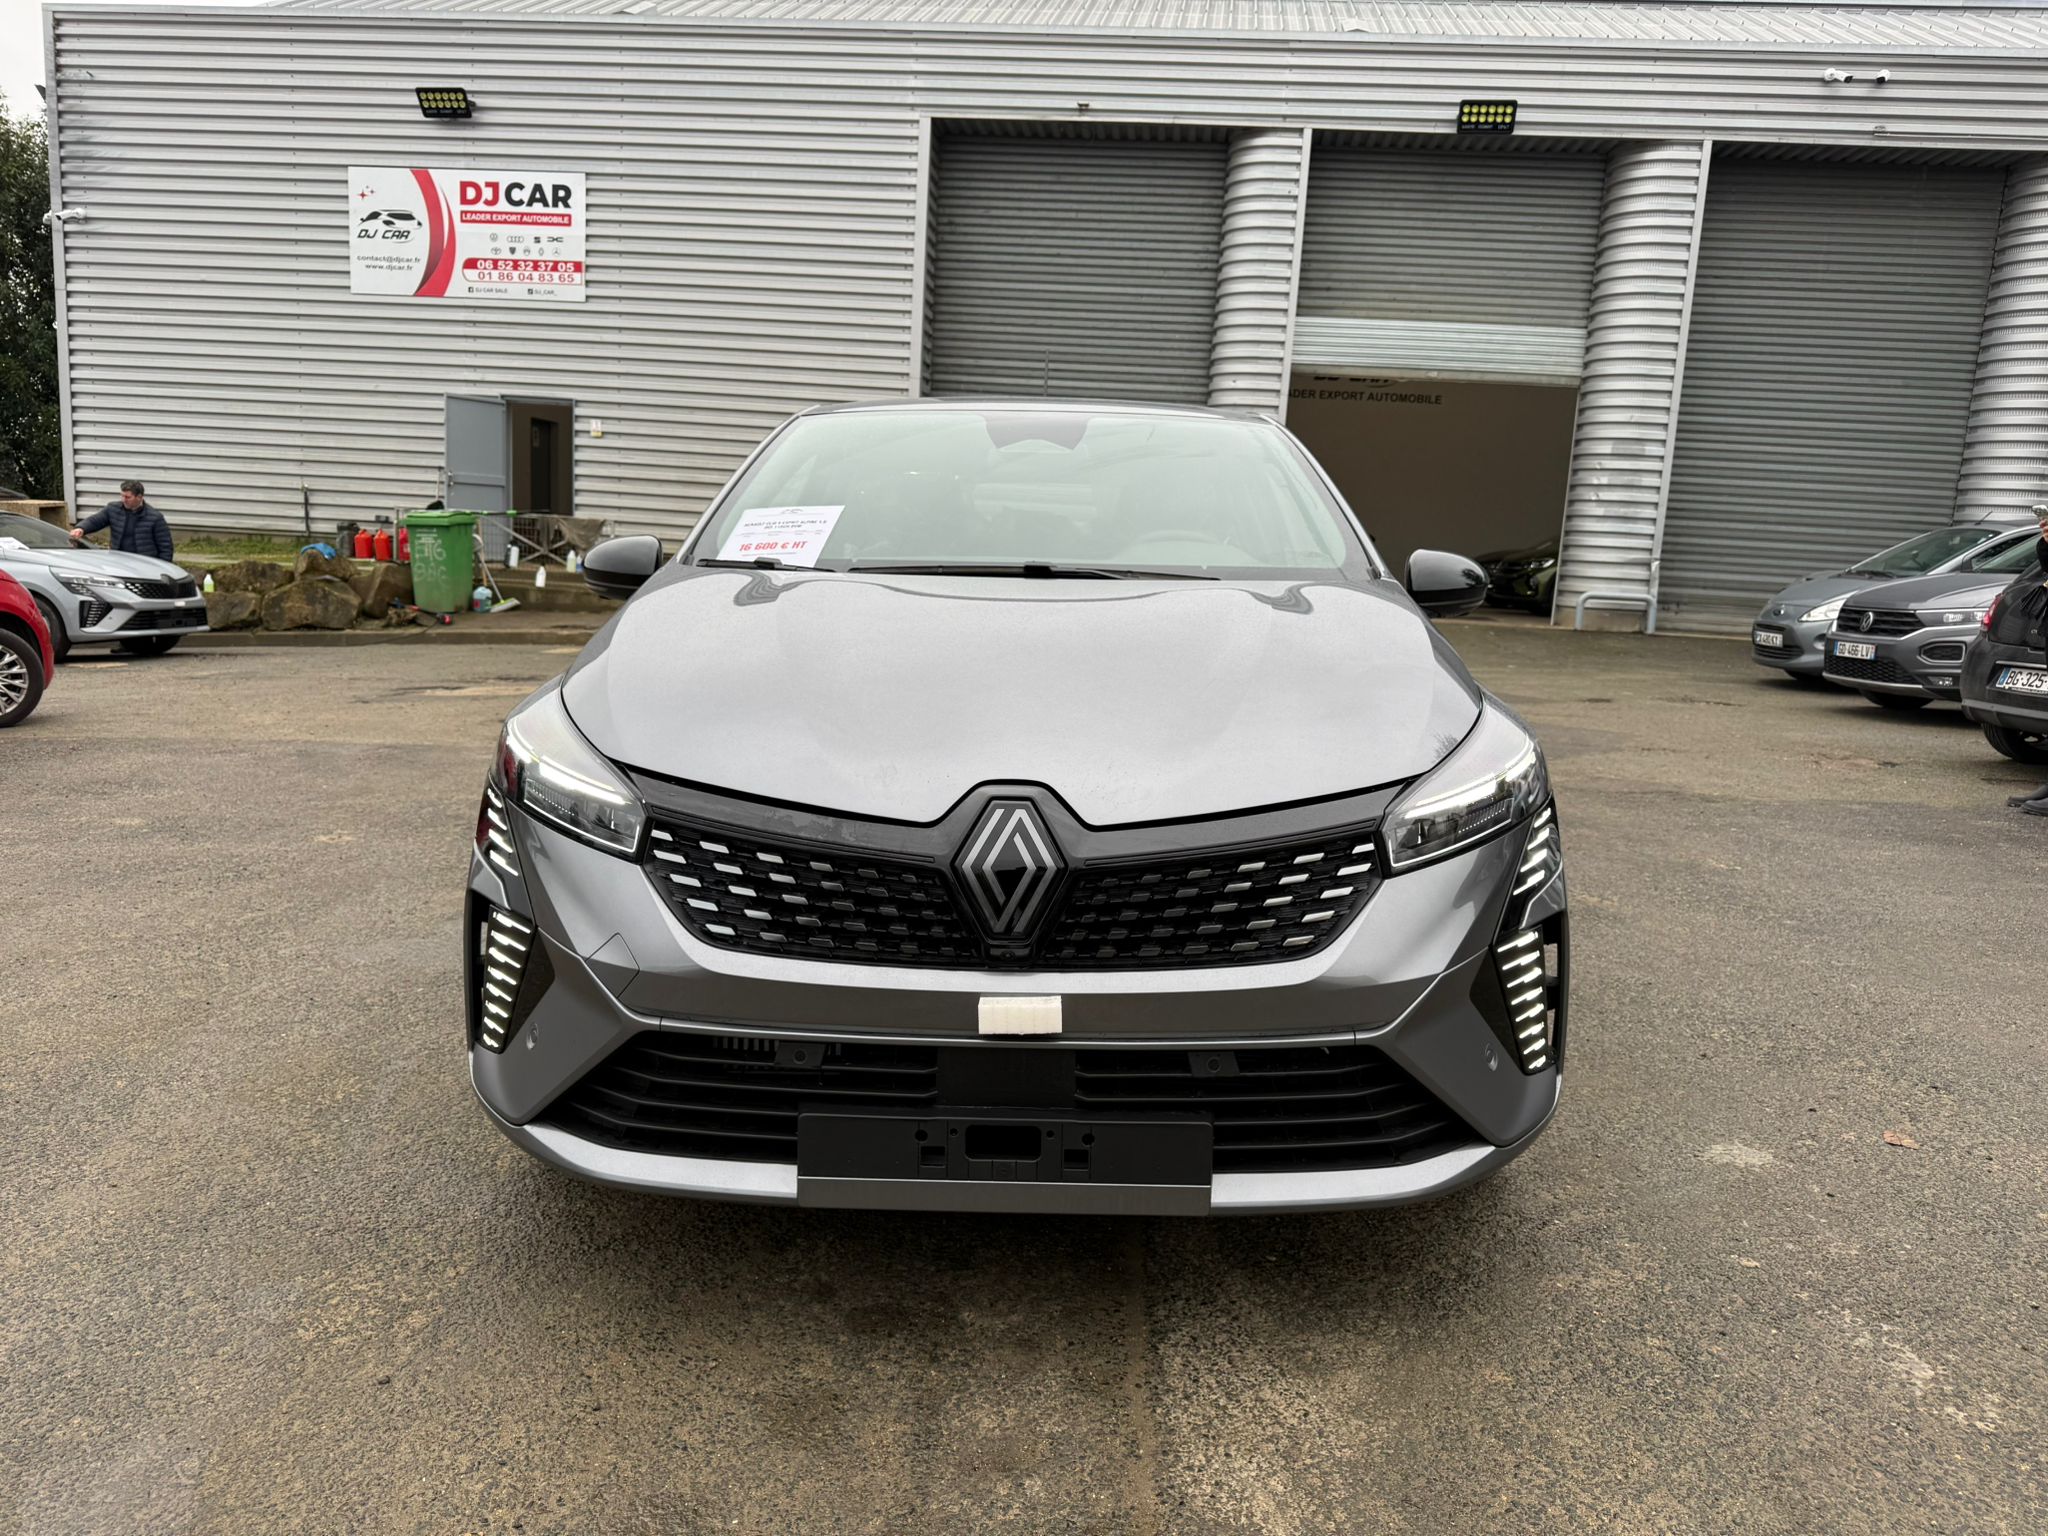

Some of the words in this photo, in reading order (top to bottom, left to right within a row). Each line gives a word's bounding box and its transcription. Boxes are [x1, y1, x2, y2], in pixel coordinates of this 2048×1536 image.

[460, 181, 499, 207] DJ
[504, 182, 572, 208] CAR
[462, 212, 492, 222] LEADER
[492, 213, 521, 223] EXPORT
[522, 214, 569, 224] AUTOMOBILE
[357, 229, 378, 238] DJ
[382, 230, 411, 240] CAR
[357, 255, 421, 264] contact@djcar.fr
[477, 259, 493, 269] 06
[497, 260, 513, 270] 52
[517, 261, 534, 271] 32
[537, 262, 554, 272] 37
[557, 262, 574, 272] 05
[478, 271, 493, 280] 01
[498, 272, 514, 281] 86
[518, 272, 533, 281] 04
[538, 273, 554, 282] 83
[558, 274, 574, 283] 65
[1319, 390, 1365, 401] EXPORT
[1366, 391, 1443, 405] AUTOMOBILE
[739, 543, 753, 552] 16
[755, 542, 779, 551] 600
[792, 540, 808, 549] HT
